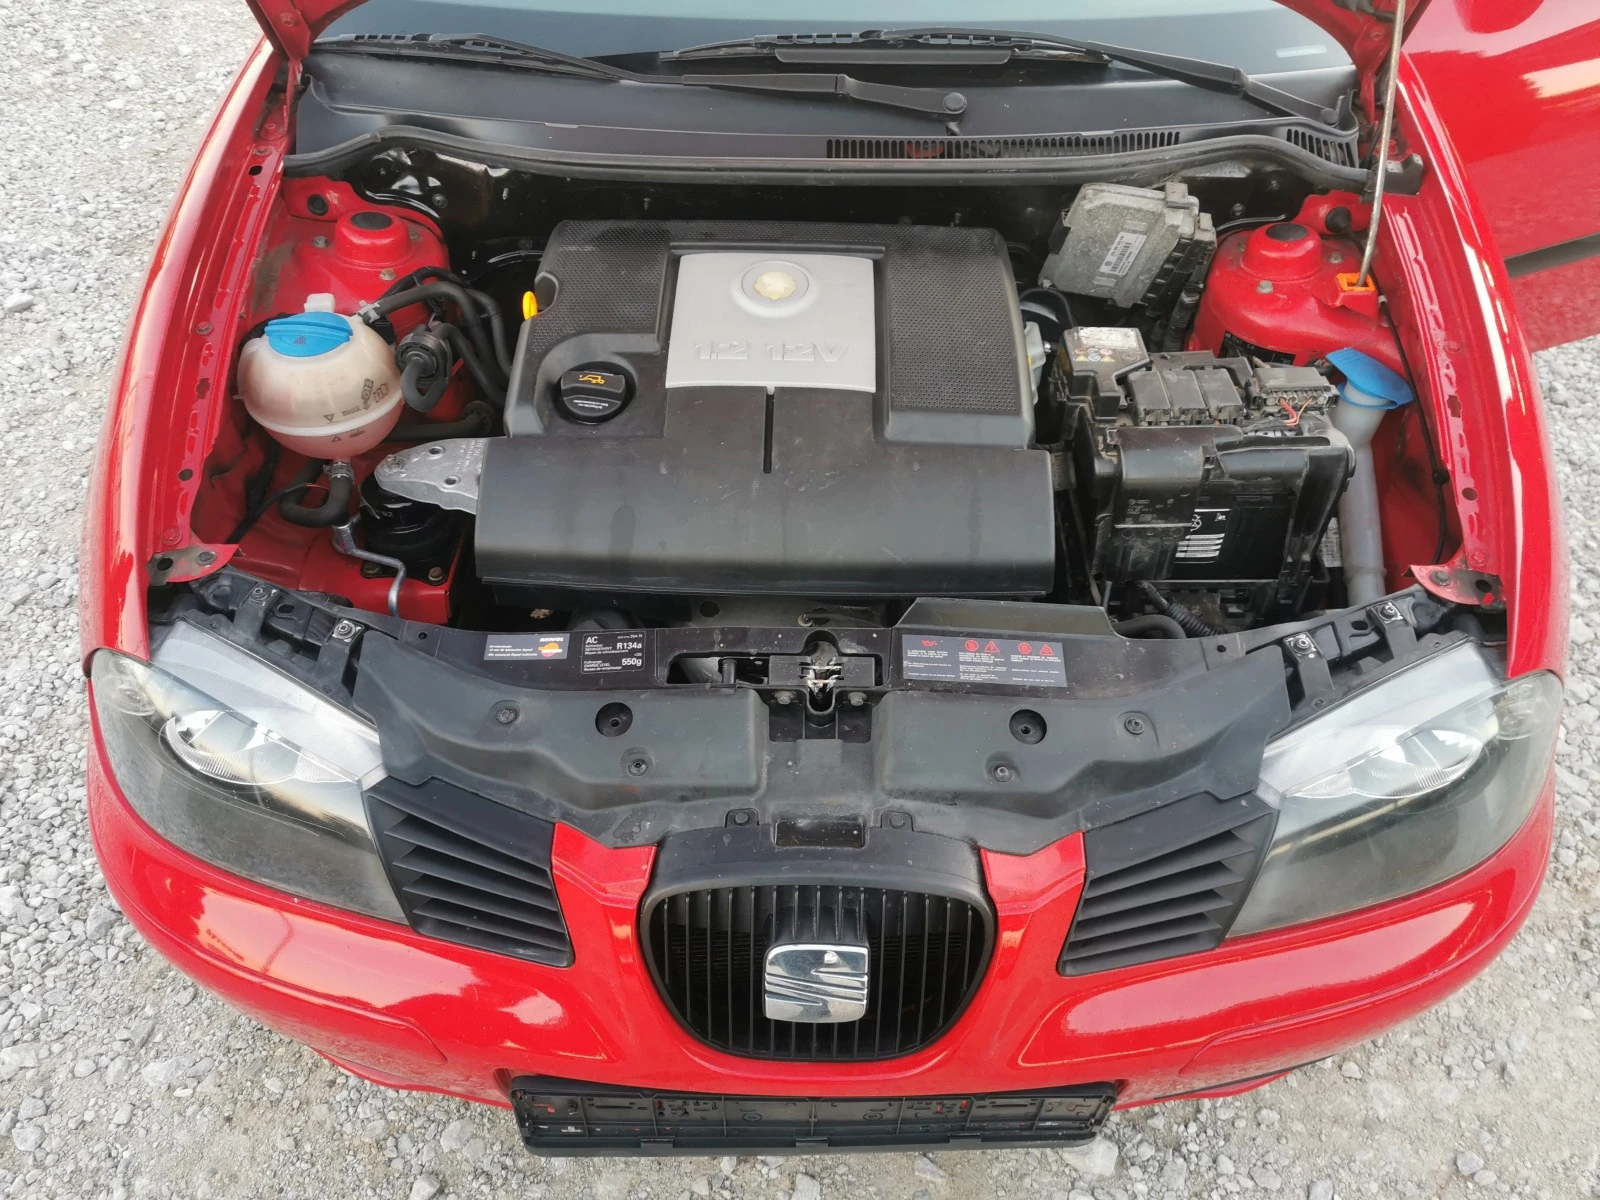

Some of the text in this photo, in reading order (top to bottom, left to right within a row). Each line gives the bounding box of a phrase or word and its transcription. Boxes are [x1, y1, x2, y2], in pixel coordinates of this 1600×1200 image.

[694, 340, 850, 363] 1.2 12V
[585, 636, 598, 644] AC
[616, 641, 642, 650] R134a
[621, 657, 642, 667] 550g
